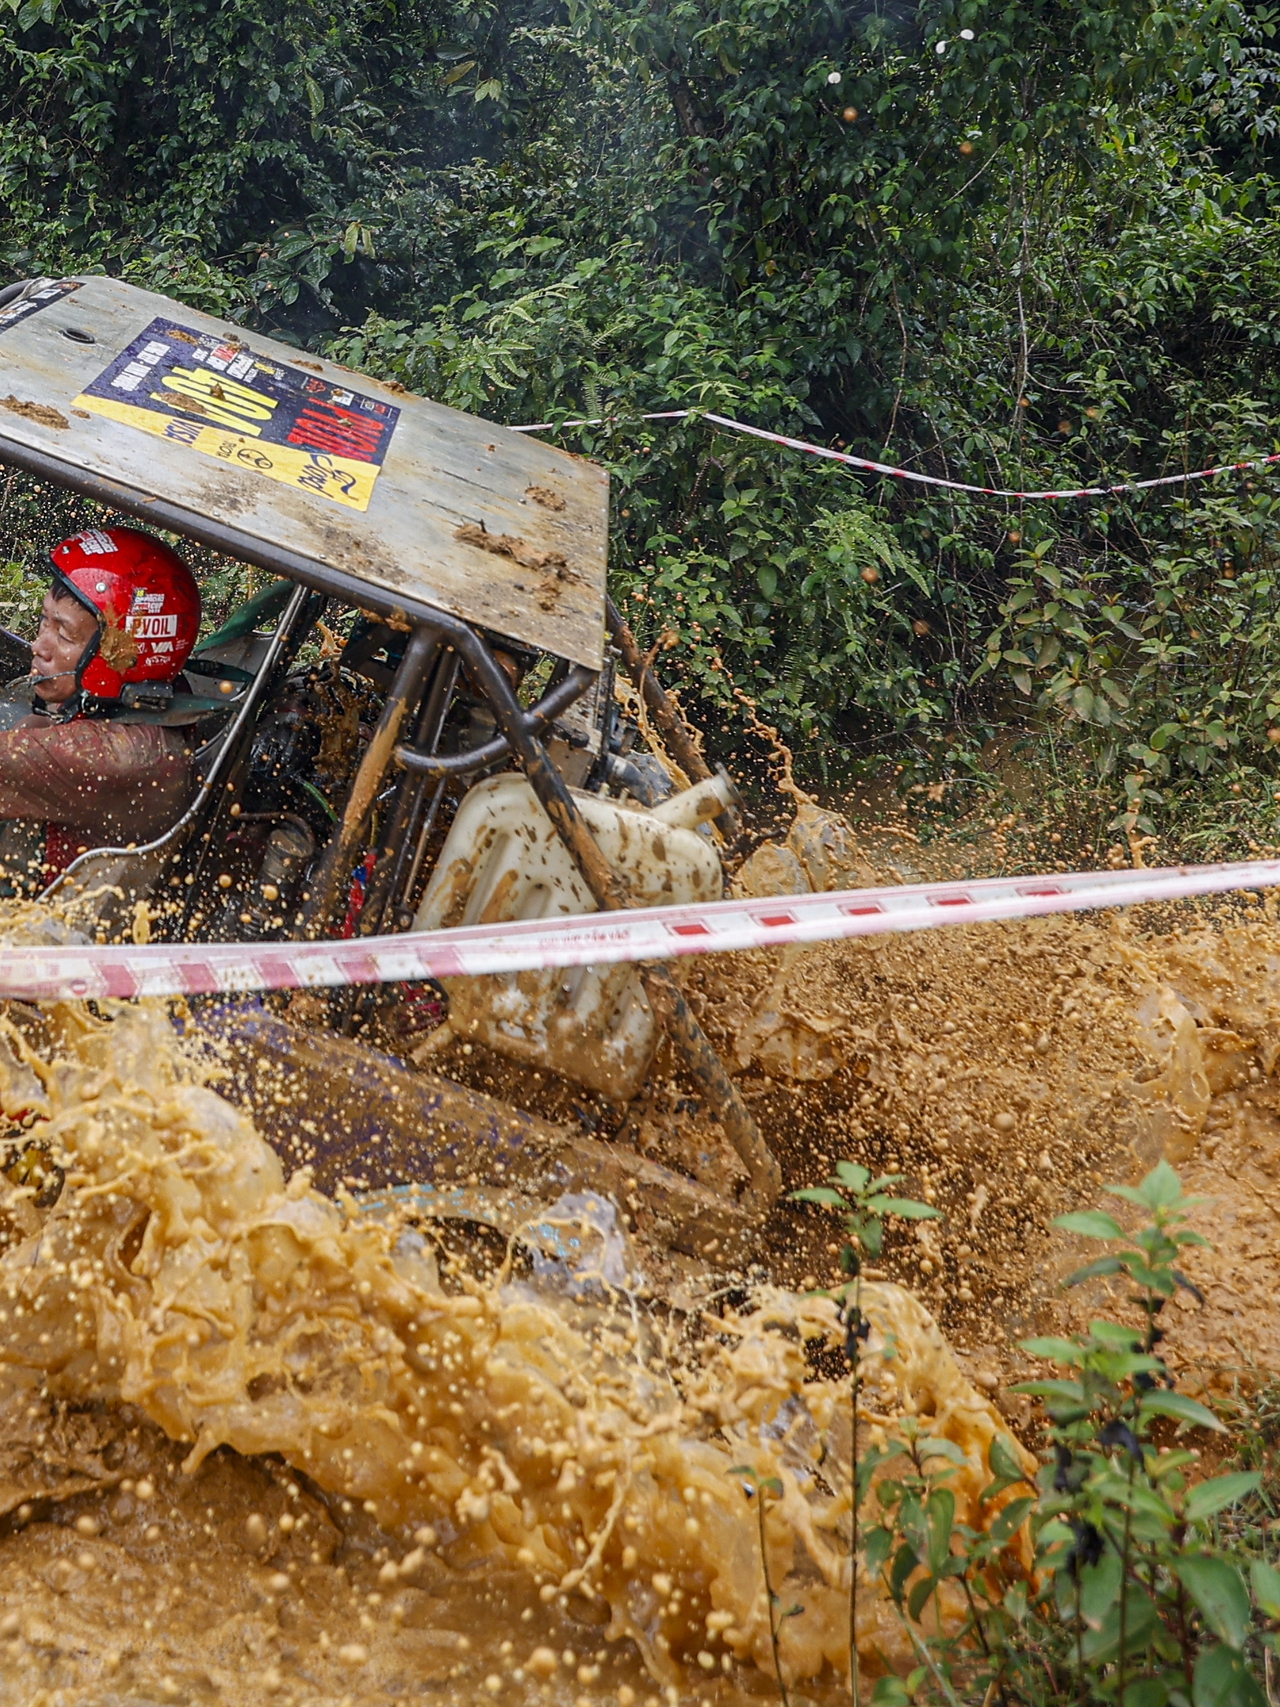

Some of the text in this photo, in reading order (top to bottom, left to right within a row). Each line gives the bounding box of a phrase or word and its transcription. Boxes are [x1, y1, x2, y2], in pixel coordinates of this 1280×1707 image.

[149, 367, 279, 436] 404
[161, 417, 204, 445] VISA
[287, 397, 385, 462] PVOIL
[133, 618, 171, 635] PVOIL
[151, 641, 174, 653] VIA
